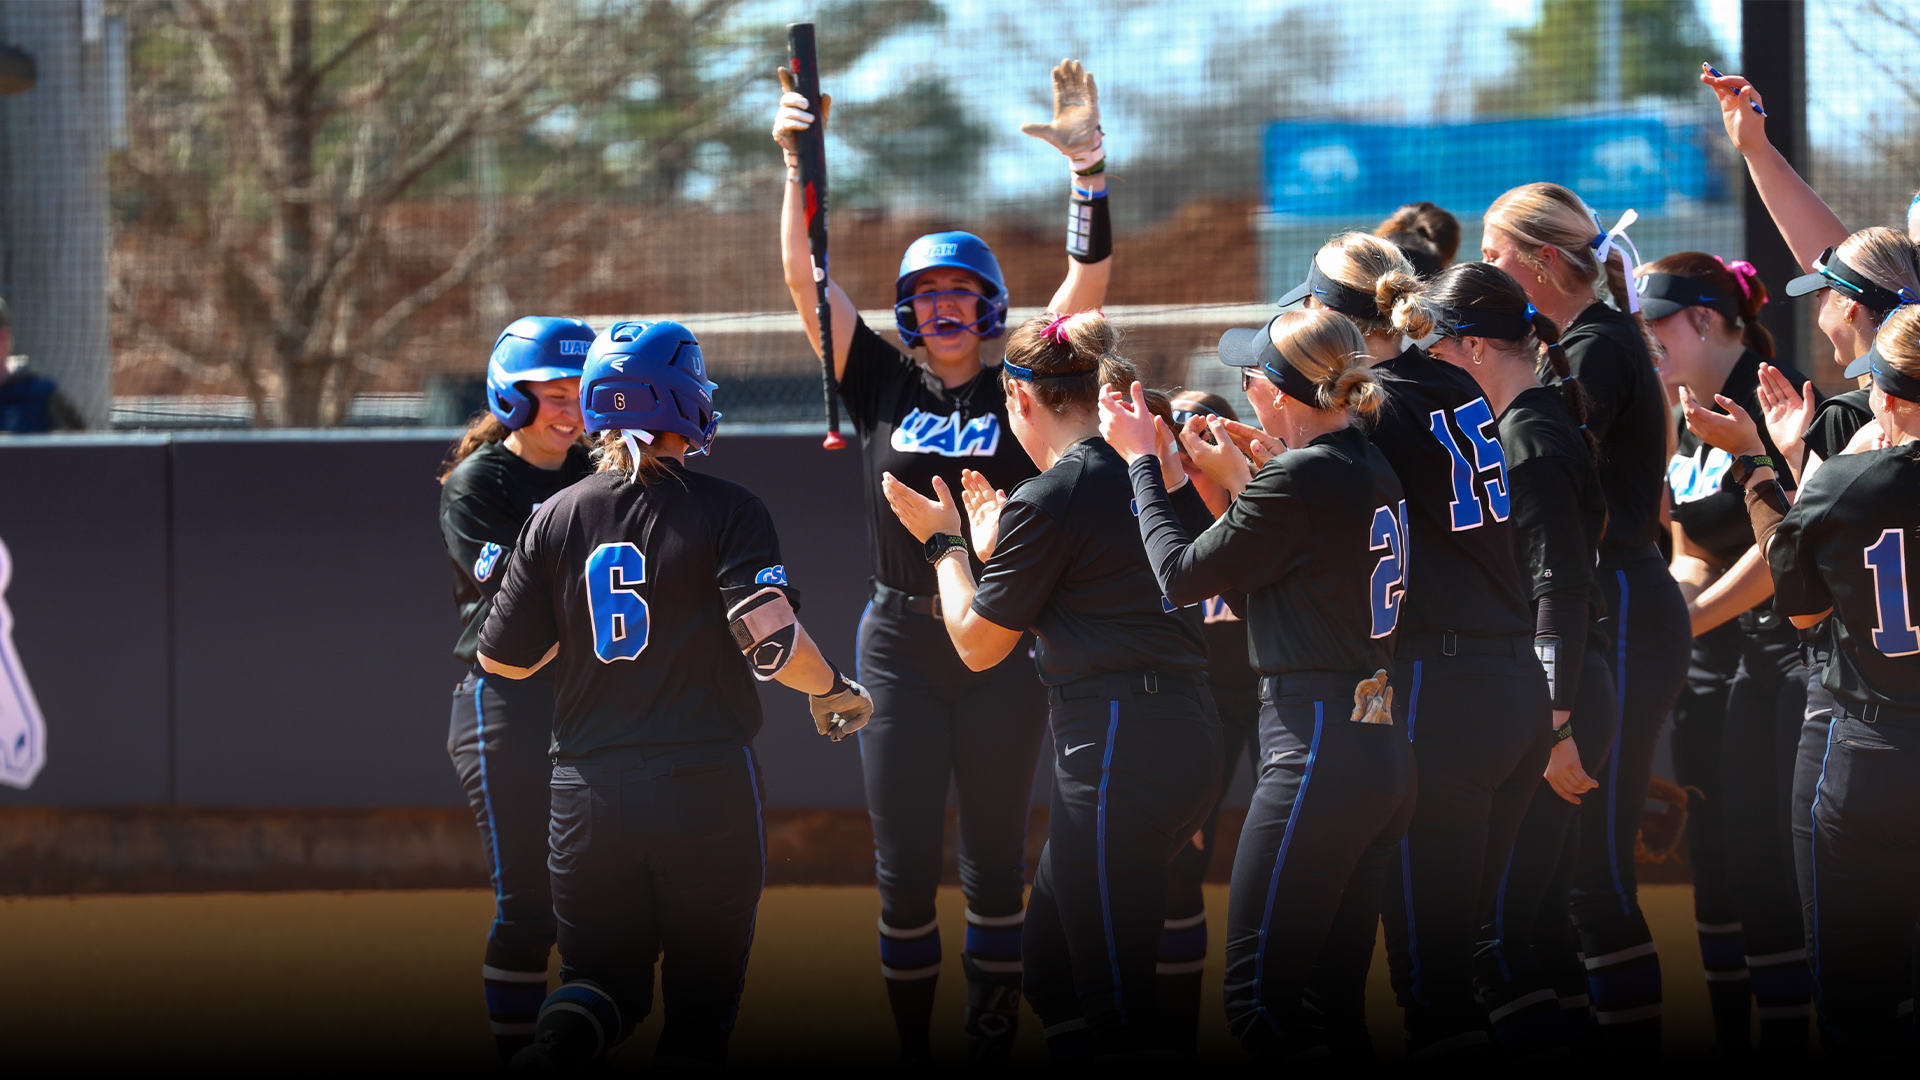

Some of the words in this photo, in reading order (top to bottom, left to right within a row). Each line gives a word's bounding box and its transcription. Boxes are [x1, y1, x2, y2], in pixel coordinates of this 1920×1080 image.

[614, 393, 625, 410] 6
[891, 407, 1000, 458] UAH
[1430, 396, 1511, 532] 15
[585, 541, 650, 664] 6
